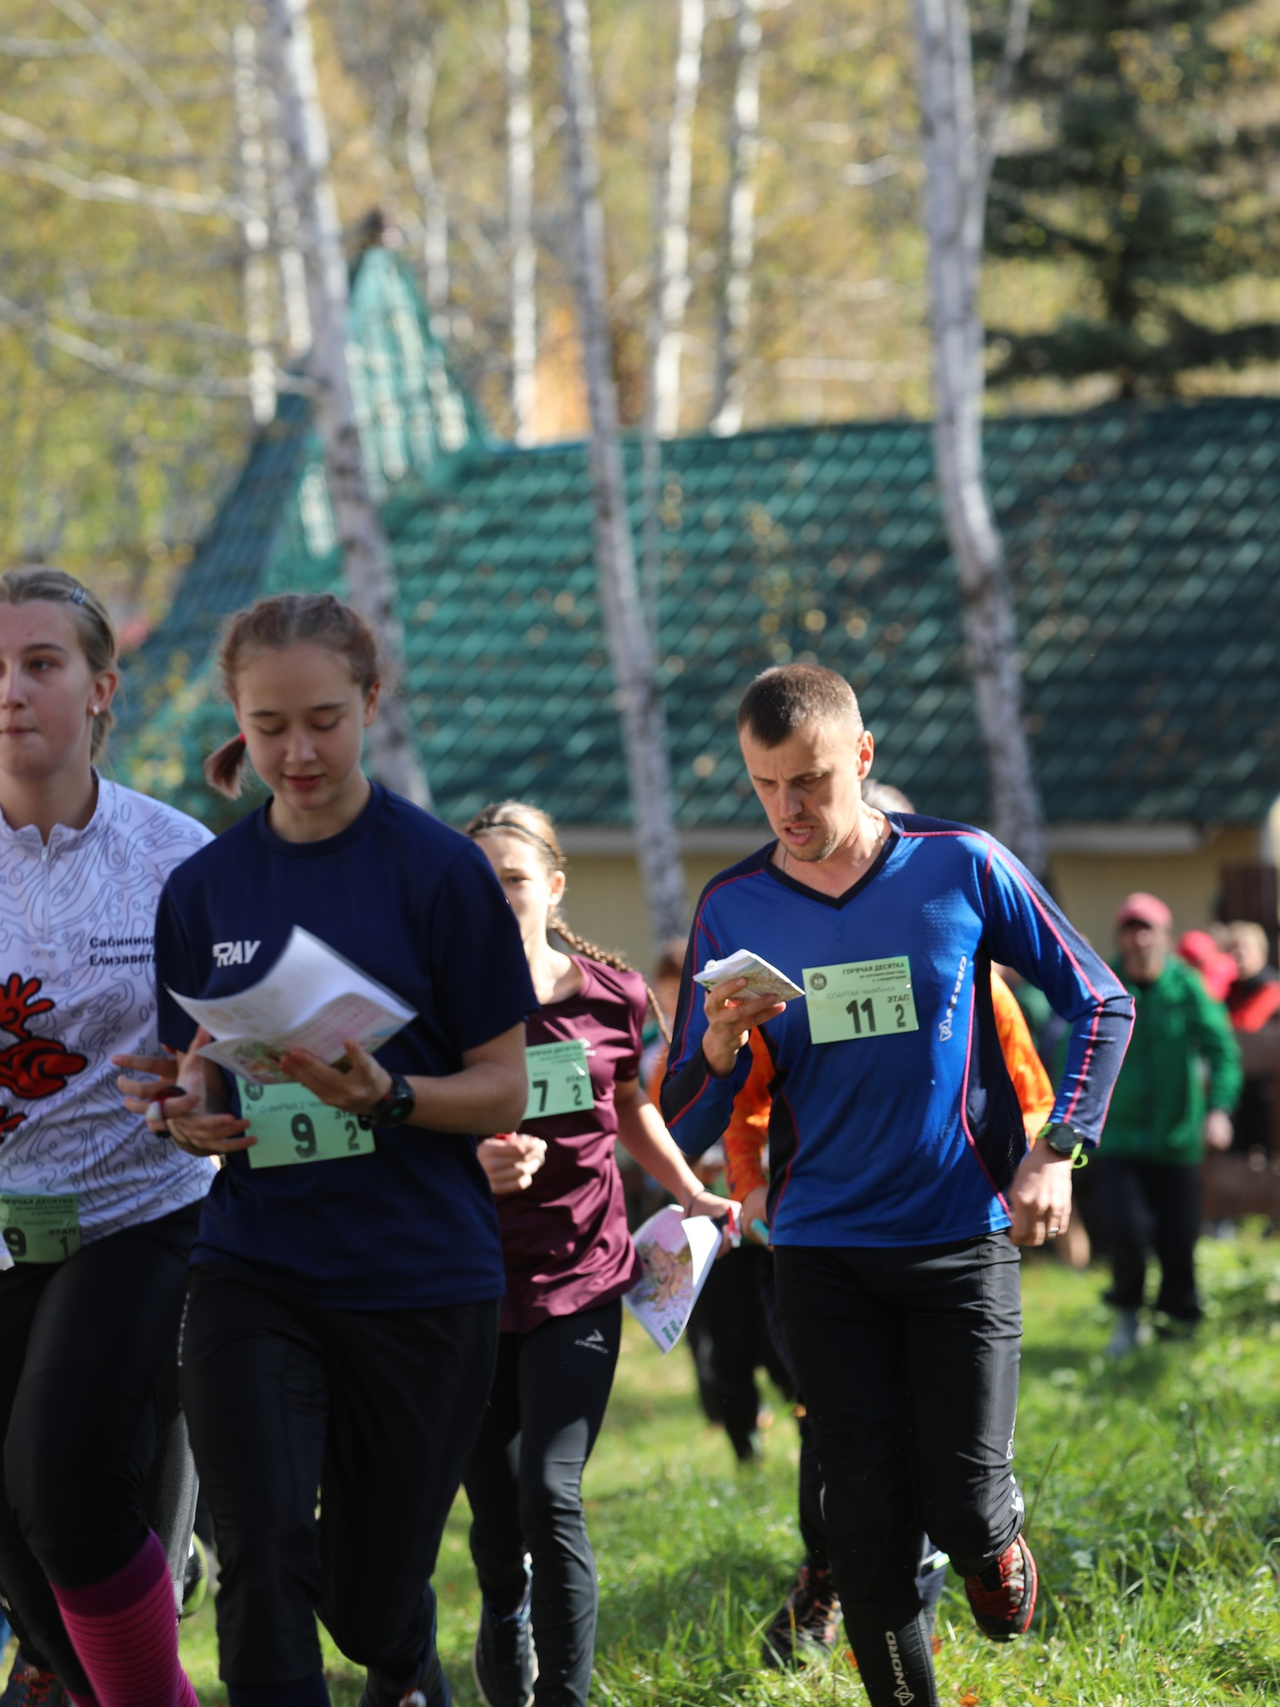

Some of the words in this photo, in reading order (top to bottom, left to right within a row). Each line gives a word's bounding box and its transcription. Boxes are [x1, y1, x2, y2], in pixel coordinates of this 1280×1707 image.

[845, 997, 876, 1034] 11
[894, 1003, 907, 1028] 2
[887, 995, 910, 1004] ЭТАП
[532, 1079, 548, 1112] 7
[572, 1084, 583, 1106] 2
[291, 1113, 318, 1158] 9
[345, 1120, 361, 1151] 2
[3, 1226, 28, 1258] 9
[59, 1236, 70, 1258] 1
[885, 1631, 907, 1685] NORD
